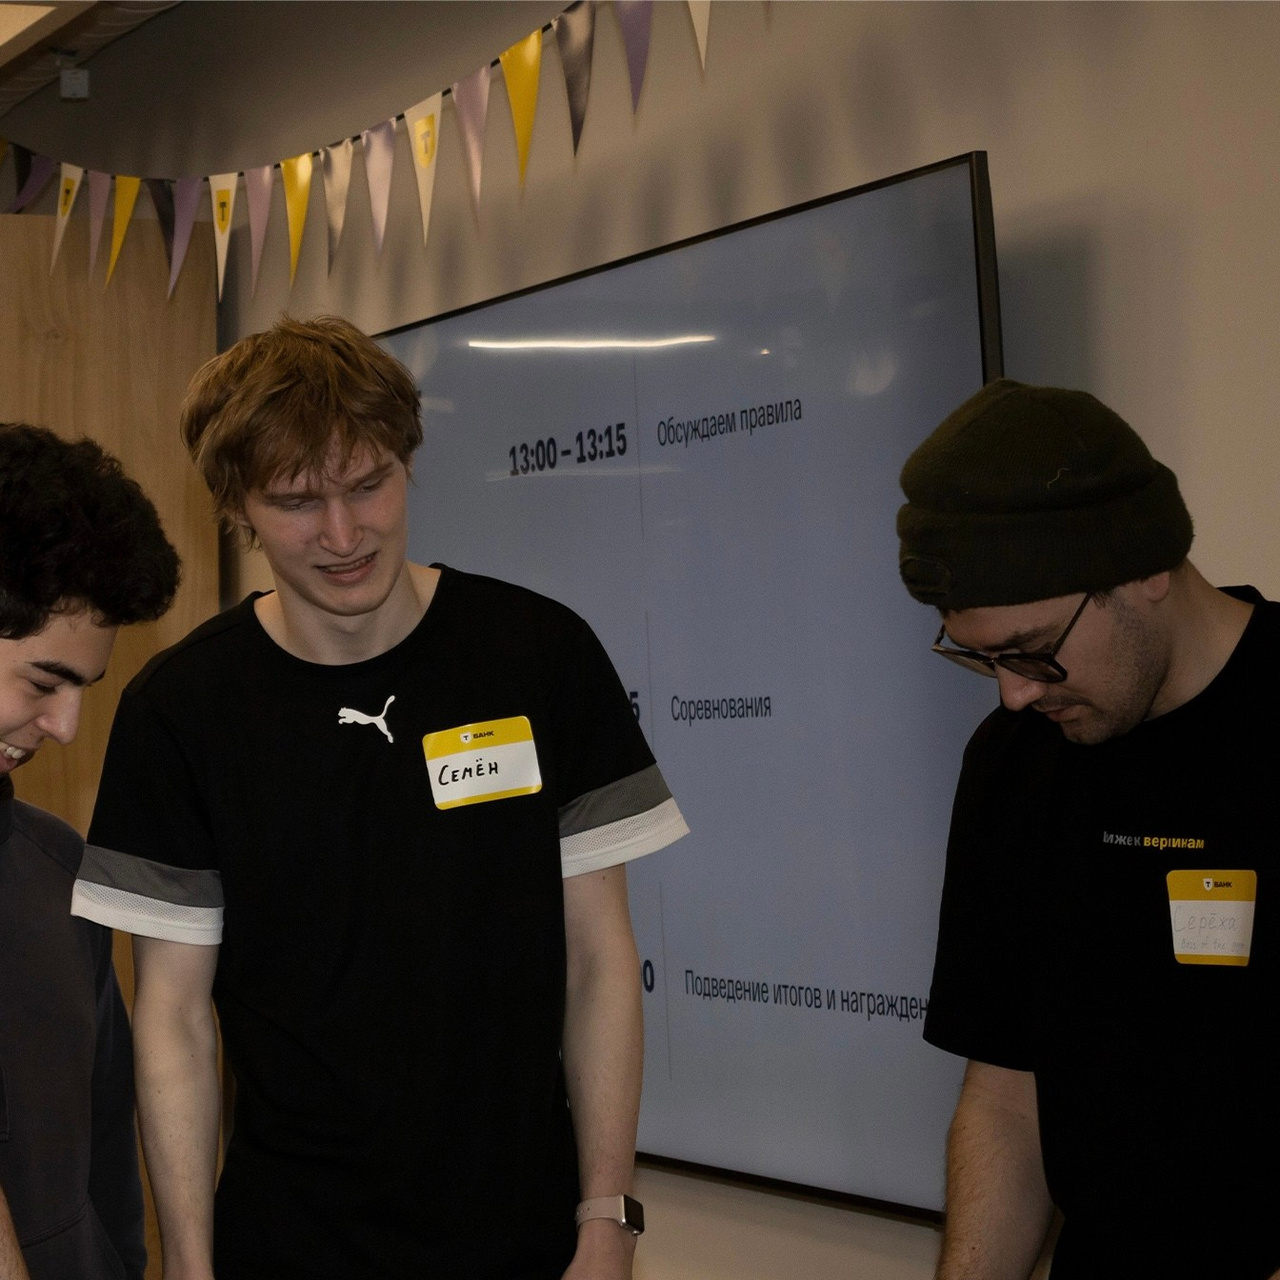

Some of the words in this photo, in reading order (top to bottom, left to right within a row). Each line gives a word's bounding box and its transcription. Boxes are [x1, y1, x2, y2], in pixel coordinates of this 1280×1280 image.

[509, 437, 558, 476] 13:00
[575, 422, 628, 464] 13:15
[657, 410, 737, 448] Обсуждаем
[740, 398, 803, 436] правила
[671, 695, 772, 727] Соревнования
[685, 969, 769, 1004] Подведение
[773, 982, 822, 1009] итогов
[826, 988, 836, 1010] и
[840, 989, 928, 1023] награжден
